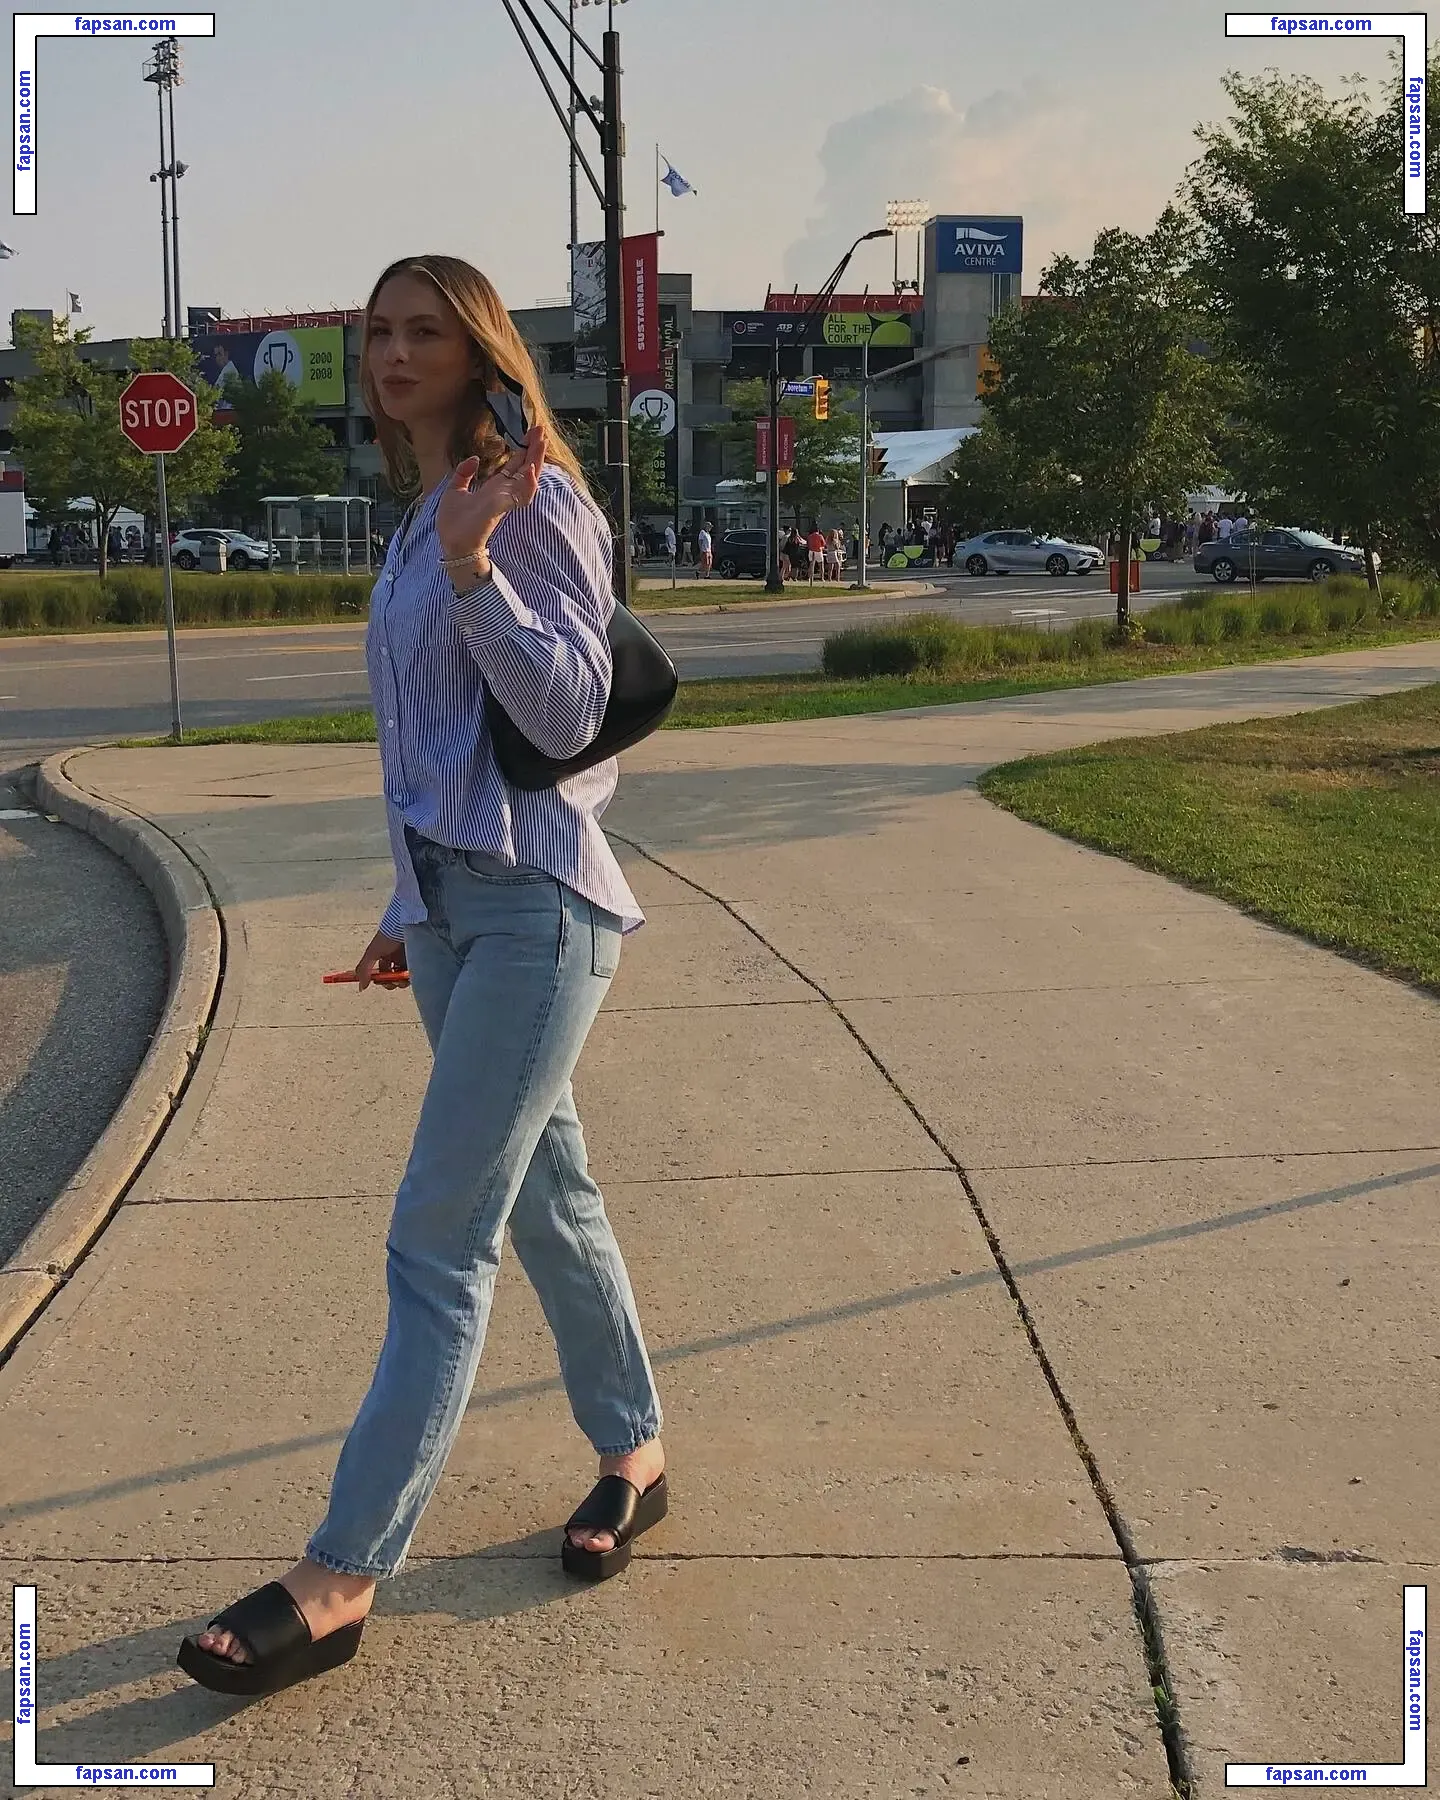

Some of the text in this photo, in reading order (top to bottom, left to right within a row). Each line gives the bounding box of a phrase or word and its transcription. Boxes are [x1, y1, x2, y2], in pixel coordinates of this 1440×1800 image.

[954, 243, 1005, 256] AVIVA
[964, 257, 997, 266] CENTRE
[636, 258, 645, 351] SUSTAINABLE
[828, 314, 847, 323] ALL
[828, 324, 871, 333] FOR THE
[828, 334, 858, 343] COURT
[664, 315, 674, 390] RAFAEL NADAL
[125, 398, 191, 428] STOP
